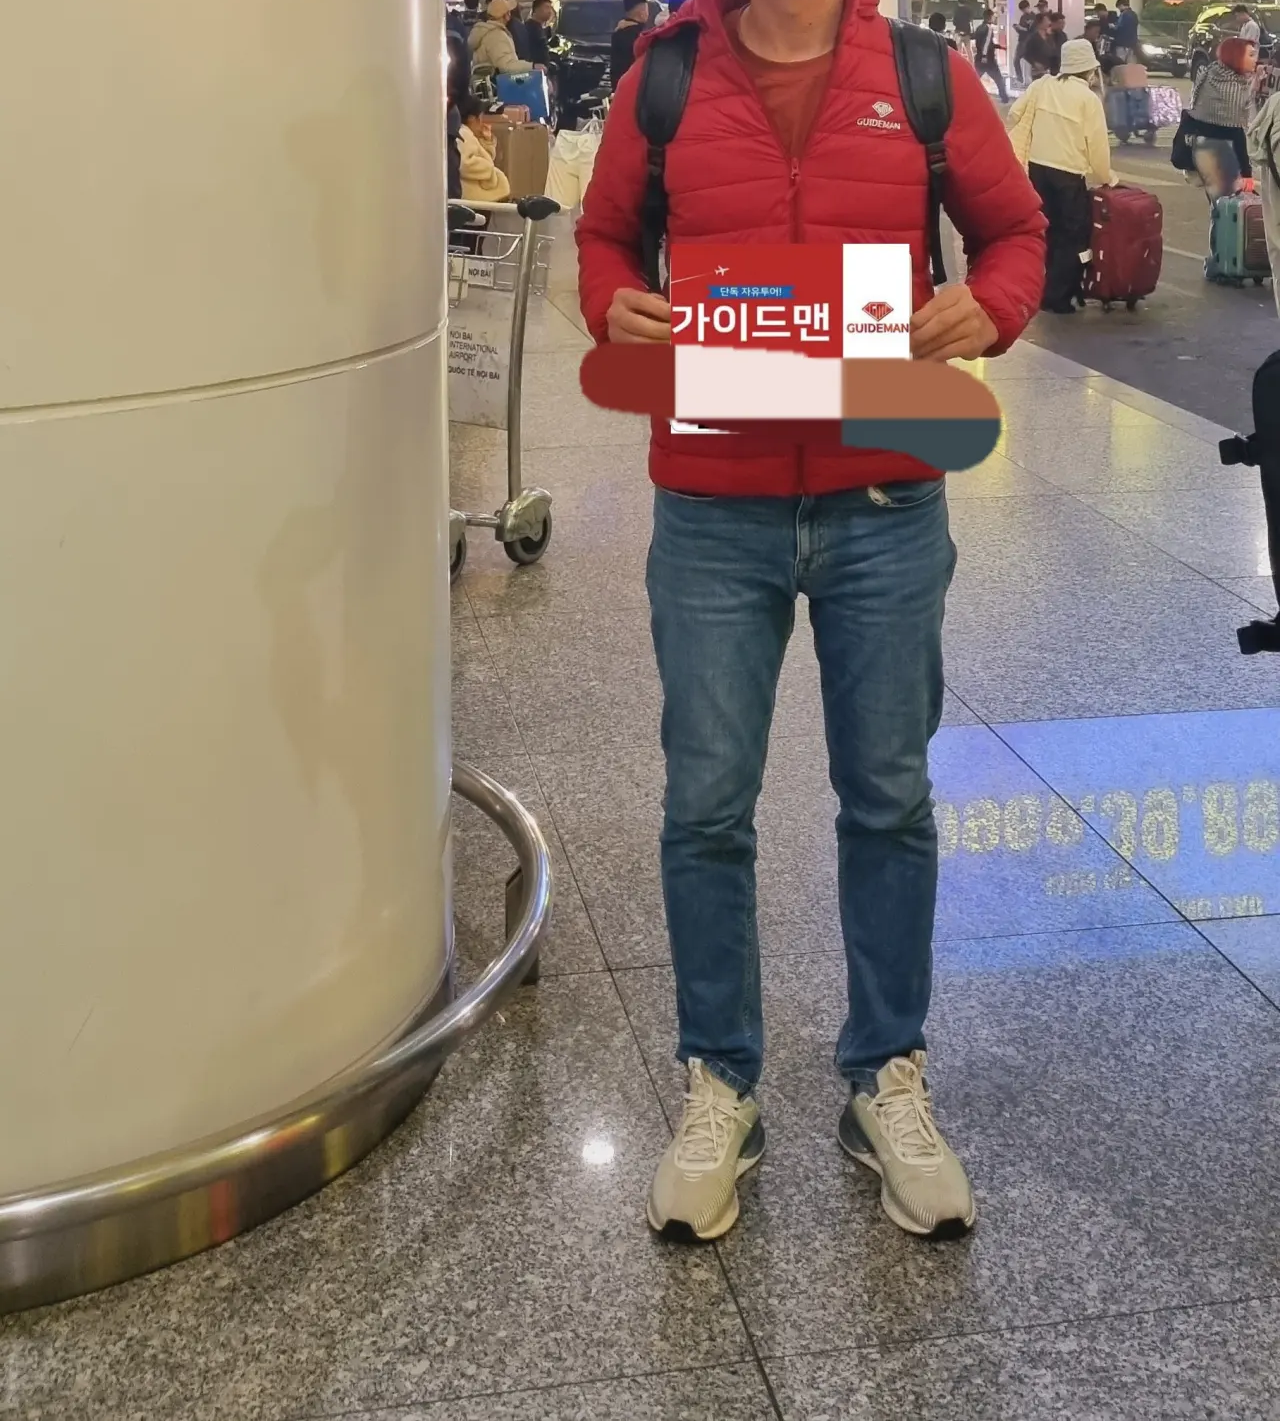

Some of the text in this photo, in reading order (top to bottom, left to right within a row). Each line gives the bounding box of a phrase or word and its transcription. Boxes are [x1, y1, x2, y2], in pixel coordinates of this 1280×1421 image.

[857, 118, 901, 130] GUIDEMAN
[720, 287, 782, 297] 단독 자유투어!
[671, 303, 830, 342] 가이드맨
[846, 323, 910, 333] GUIDEMAN
[450, 340, 499, 355] INTERNATIONAL
[449, 350, 477, 363] AIRPORT
